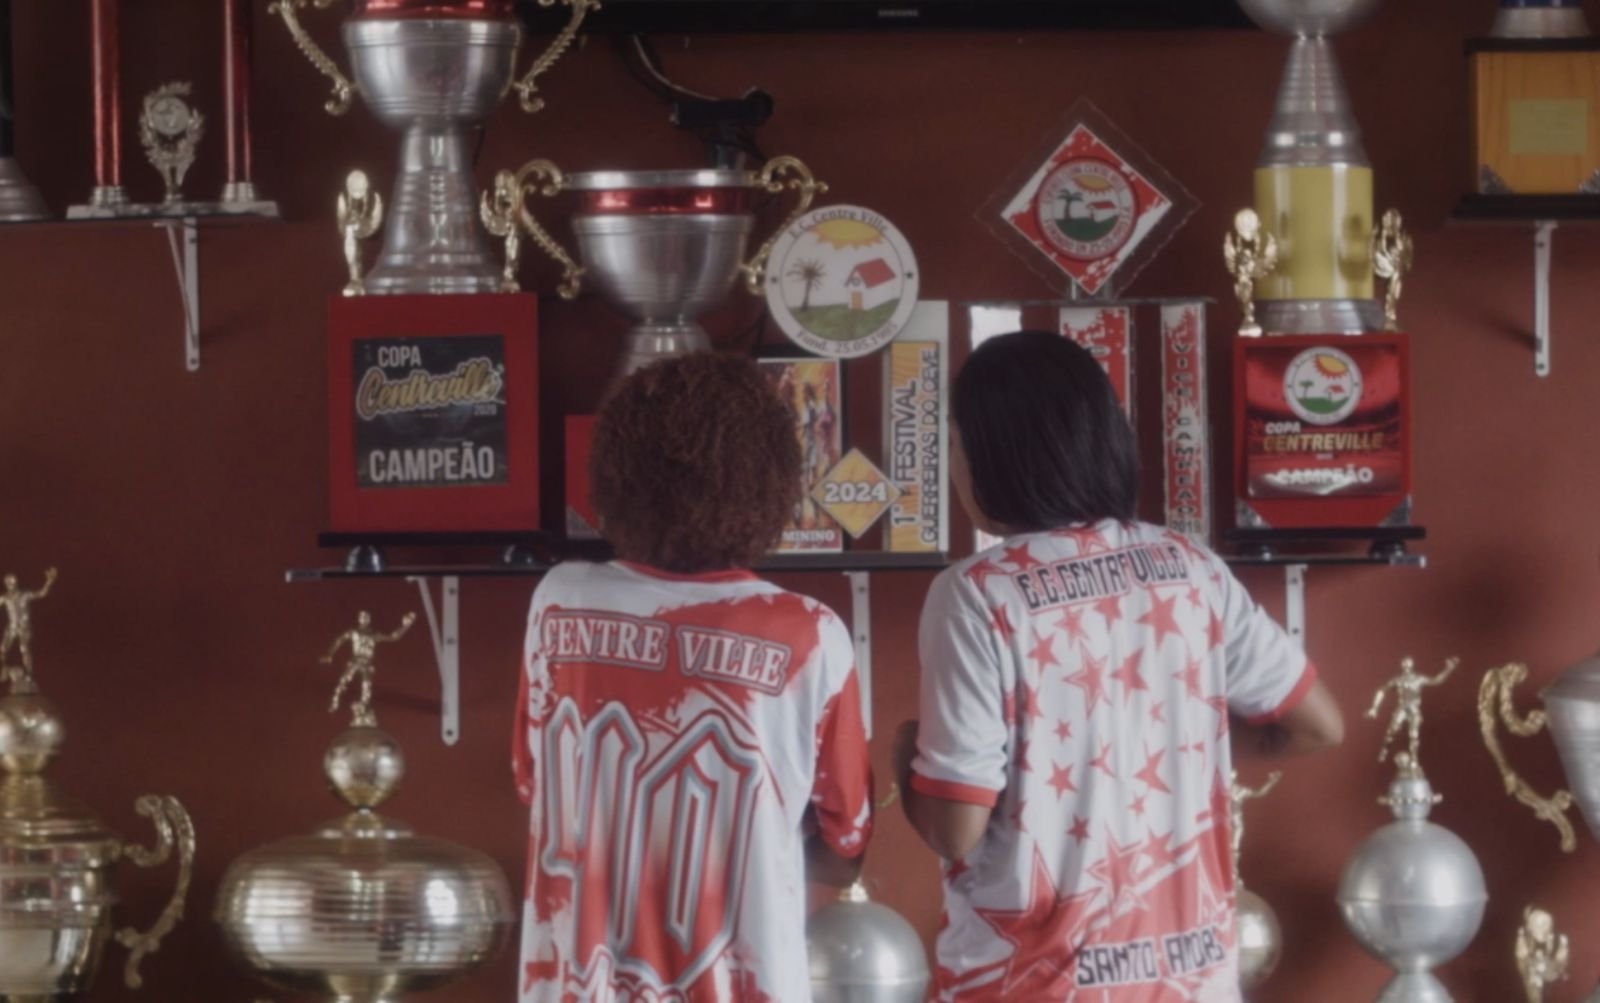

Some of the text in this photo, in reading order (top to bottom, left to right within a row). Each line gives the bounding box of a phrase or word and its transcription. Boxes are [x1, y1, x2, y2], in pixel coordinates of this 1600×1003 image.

[812, 208, 857, 224] Centre
[861, 209, 888, 232] Ville
[378, 346, 421, 367] COPA
[356, 356, 504, 421] Centreville
[894, 379, 916, 482] FESTIVAL
[921, 399, 939, 426] DO
[1265, 421, 1302, 435] COPA
[369, 441, 495, 483] CAMPEÃO
[1263, 432, 1386, 453] CENTREVILLE
[824, 481, 887, 503] 2024
[921, 432, 939, 543] GUERREIRAS
[1127, 544, 1190, 584] VILLE
[543, 615, 787, 689] CENTRE VILLE
[1077, 942, 1158, 985] SANTO
